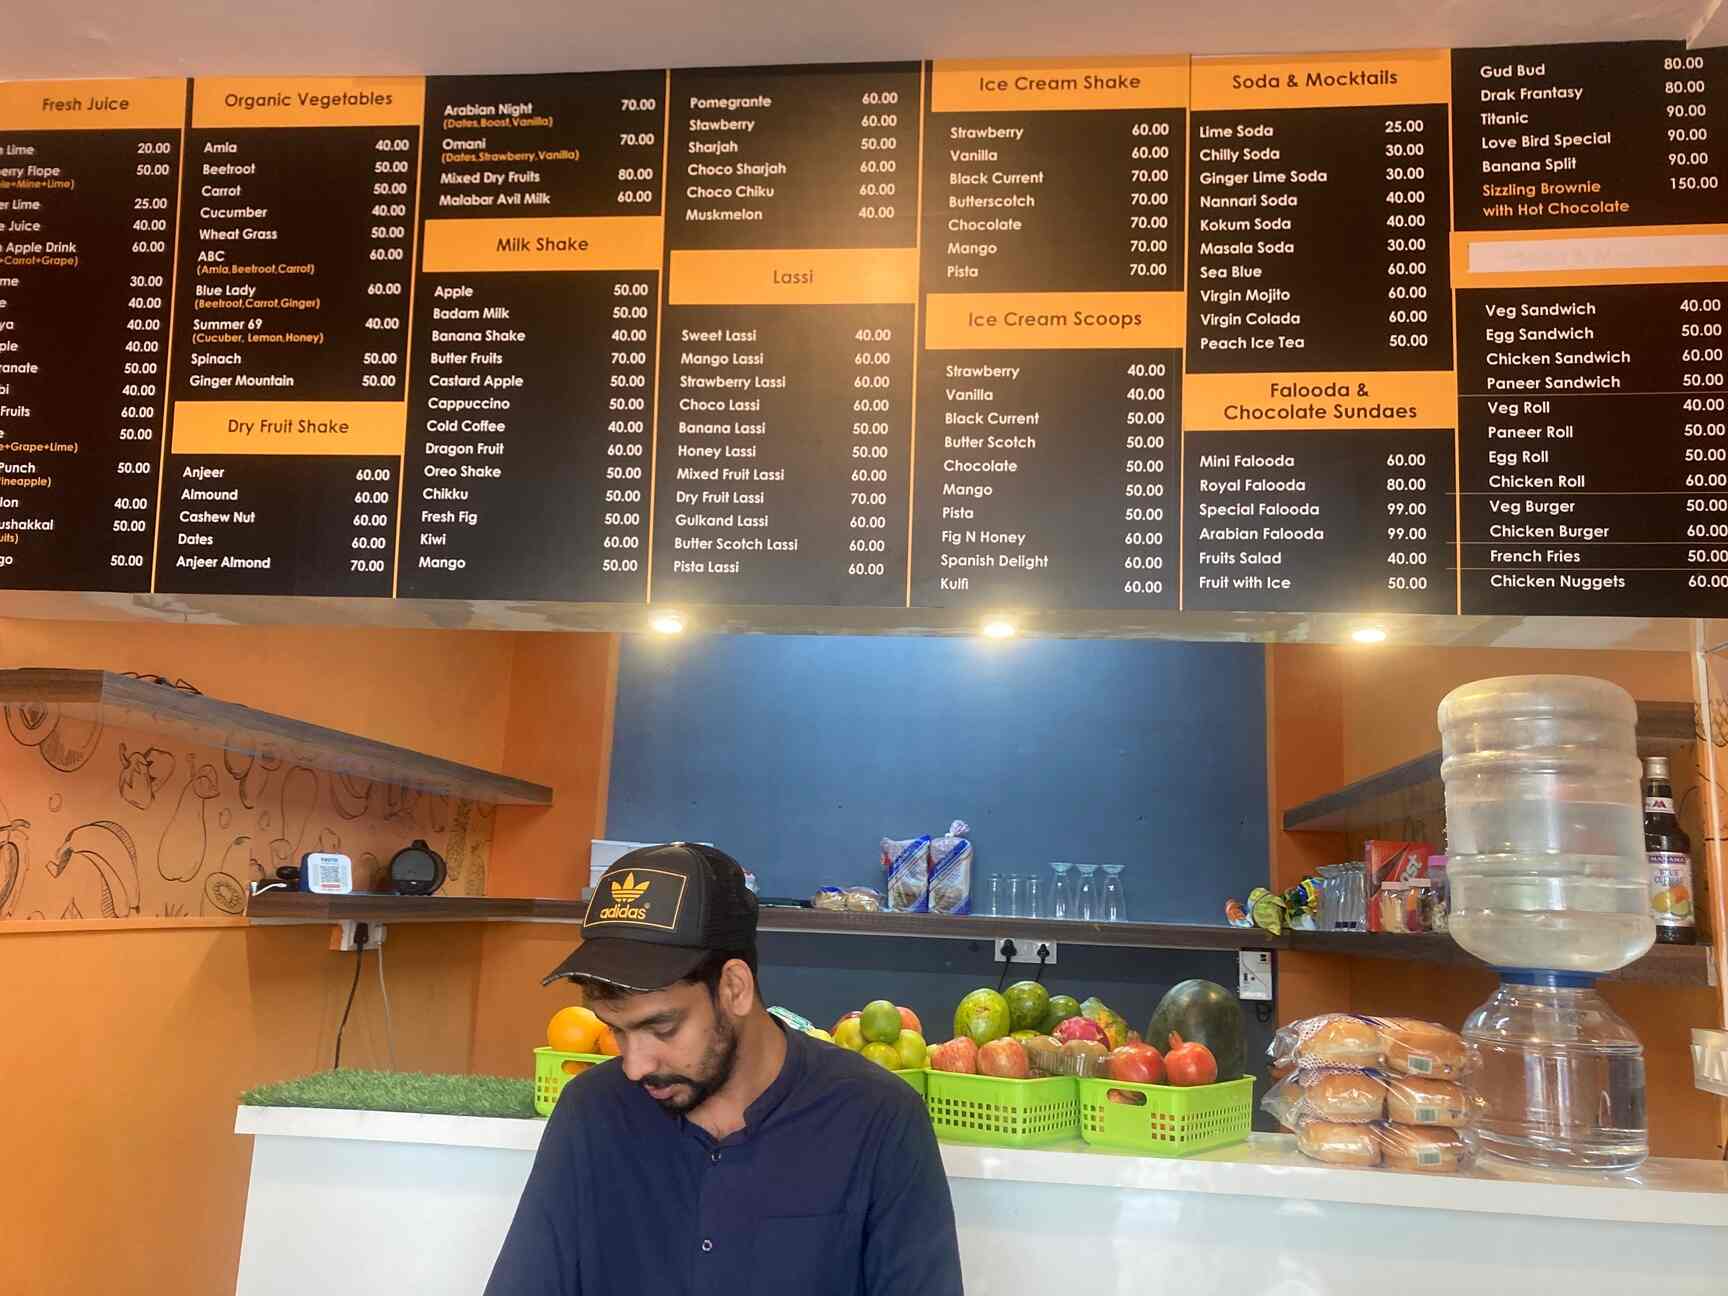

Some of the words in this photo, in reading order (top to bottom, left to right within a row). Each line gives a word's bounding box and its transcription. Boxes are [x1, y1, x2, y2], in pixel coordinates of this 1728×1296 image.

[1480, 65, 1512, 78] Gud
[1517, 63, 1545, 76] Bud
[980, 77, 1008, 91] Ice
[1015, 77, 1077, 90] Cream
[1084, 75, 1140, 89] Shake
[1233, 74, 1279, 89] Soda
[1287, 74, 1298, 87] &
[1306, 70, 1397, 86] Mocktails
[862, 92, 898, 104] 60.00
[1481, 89, 1516, 101] Drak
[1520, 86, 1583, 100] Frantasy
[42, 98, 82, 111] Fresh
[87, 97, 129, 111] Juice
[225, 92, 291, 110] Organic
[298, 92, 392, 109] Vegetables
[621, 99, 656, 111] 70.00
[690, 96, 771, 110] Pomegrante
[444, 104, 495, 116] Arabian
[498, 102, 533, 117] Night
[1666, 104, 1706, 117] 90.00
[689, 119, 755, 132] Stawberry
[1132, 123, 1169, 136] 60.00
[1200, 126, 1233, 138] Lime
[1237, 124, 1273, 137] Soda
[950, 126, 1024, 140] Strawberry
[375, 139, 409, 151] 40.00
[442, 138, 486, 150] Omani
[1482, 137, 1517, 149] Love
[1522, 134, 1549, 147] Bird
[1554, 132, 1611, 148] Special
[6, 144, 35, 155] Lime
[137, 143, 170, 154] 20.00
[204, 142, 237, 153] Amla
[688, 164, 733, 175] Choco
[736, 162, 786, 177] Sharjah
[950, 172, 988, 184] Black
[992, 171, 1044, 184] Current
[1200, 172, 1249, 186] Ginger
[1253, 171, 1286, 183] Lime
[1290, 170, 1327, 182] Soda
[1670, 176, 1718, 189] 150.00
[1483, 184, 1536, 198] Sizzling
[1541, 181, 1600, 194] Brownie
[134, 198, 167, 209] 25.00
[439, 194, 494, 206] Malabar
[497, 193, 521, 205] Avil
[524, 192, 550, 204] Milk
[949, 194, 1035, 208] Butterscotch
[200, 206, 267, 218] Cucumber
[686, 208, 762, 221] Muskmelon
[1483, 204, 1513, 216] with
[1518, 203, 1543, 215] Hot
[1548, 200, 1629, 215] Chocolate
[8, 220, 41, 231] Juice
[1201, 219, 1250, 231] Kokum
[1254, 217, 1291, 230] Soda
[199, 228, 240, 240] Wheat
[242, 228, 277, 240] Grass
[5, 242, 42, 255] Apple
[46, 241, 76, 253] Drink
[497, 238, 530, 251] Milk
[536, 237, 589, 251] Shake
[774, 270, 813, 284] Lassi
[947, 265, 979, 278] Pista
[196, 285, 223, 296] Blue
[226, 284, 256, 298] Lady
[368, 283, 401, 295] 60.00
[434, 285, 473, 299] Apple
[1200, 289, 1241, 304] Virgin
[1246, 288, 1290, 303] Mojito
[193, 319, 245, 330] Summer
[248, 318, 263, 330] 69
[968, 312, 997, 327] Ice
[1004, 312, 1067, 326] Cream
[1074, 311, 1142, 329] Scoops
[1389, 334, 1428, 347] 50.00
[1486, 329, 1514, 343] Egg
[1519, 327, 1594, 340] Sandwich
[1201, 337, 1247, 349] Peach
[1251, 337, 1274, 349] Ice
[1278, 336, 1304, 348] Tea
[431, 352, 468, 364] Butter
[470, 352, 503, 364] Fruits
[1682, 348, 1723, 361] 60.00
[189, 375, 233, 389] Ginger
[235, 374, 294, 386] Mountain
[362, 375, 396, 386] 50.00
[680, 375, 751, 390] Strawberry
[755, 376, 786, 388] Lassi
[122, 384, 155, 396] 40.00
[1271, 382, 1349, 398] Falooda
[1357, 383, 1368, 397] &
[0, 405, 30, 417] Fruits
[1224, 404, 1327, 420] Chocolate
[1333, 404, 1416, 419] Sundaes
[228, 419, 254, 436] Dry
[260, 419, 292, 433] Fruit
[298, 419, 349, 434] Shake
[427, 420, 458, 431] Cold
[461, 420, 506, 432] Coffee
[608, 421, 643, 433] 40.00
[945, 436, 984, 448] Butter
[987, 436, 1036, 448] Scotch
[678, 445, 722, 459] Honey
[725, 445, 756, 457] Lassi
[1489, 451, 1517, 466] Egg
[1522, 450, 1548, 463] Roll
[424, 465, 457, 477] Oreo
[460, 465, 501, 477] Shake
[1200, 479, 1240, 494] Royal
[1245, 478, 1306, 491] Falooda
[1686, 474, 1727, 486] 60.00
[181, 488, 238, 500] Almound
[851, 492, 886, 505] 70.00
[1387, 503, 1426, 515] 99.00
[179, 511, 230, 523] Cashew
[233, 512, 255, 523] Nut
[675, 514, 733, 526] Gulkand
[737, 515, 768, 527] Lassi
[113, 520, 146, 532] 50.00
[1490, 525, 1554, 537] Chicken
[1559, 525, 1609, 540] Burger
[420, 533, 446, 545] Kiwi
[603, 536, 639, 548] 60.00
[942, 530, 961, 545] Fig
[966, 531, 976, 542] N
[980, 531, 1026, 546] Honey
[1125, 532, 1163, 544] 60.00
[176, 555, 218, 570] Anjeer
[221, 556, 271, 568] Almond
[1200, 552, 1236, 564] Fruits
[1240, 552, 1281, 564] Salad
[350, 560, 384, 572] 70.00
[674, 560, 704, 572] Pista
[708, 561, 739, 573] Lassi
[941, 578, 968, 590] Kulfi
[1200, 576, 1229, 588] Fruit
[1233, 576, 1262, 588] with
[1267, 576, 1291, 589] Ice
[1490, 574, 1555, 587] Chicken
[1560, 575, 1625, 590] Nuggets
[1688, 575, 1728, 588] 60.00
[599, 903, 647, 920] adidas
